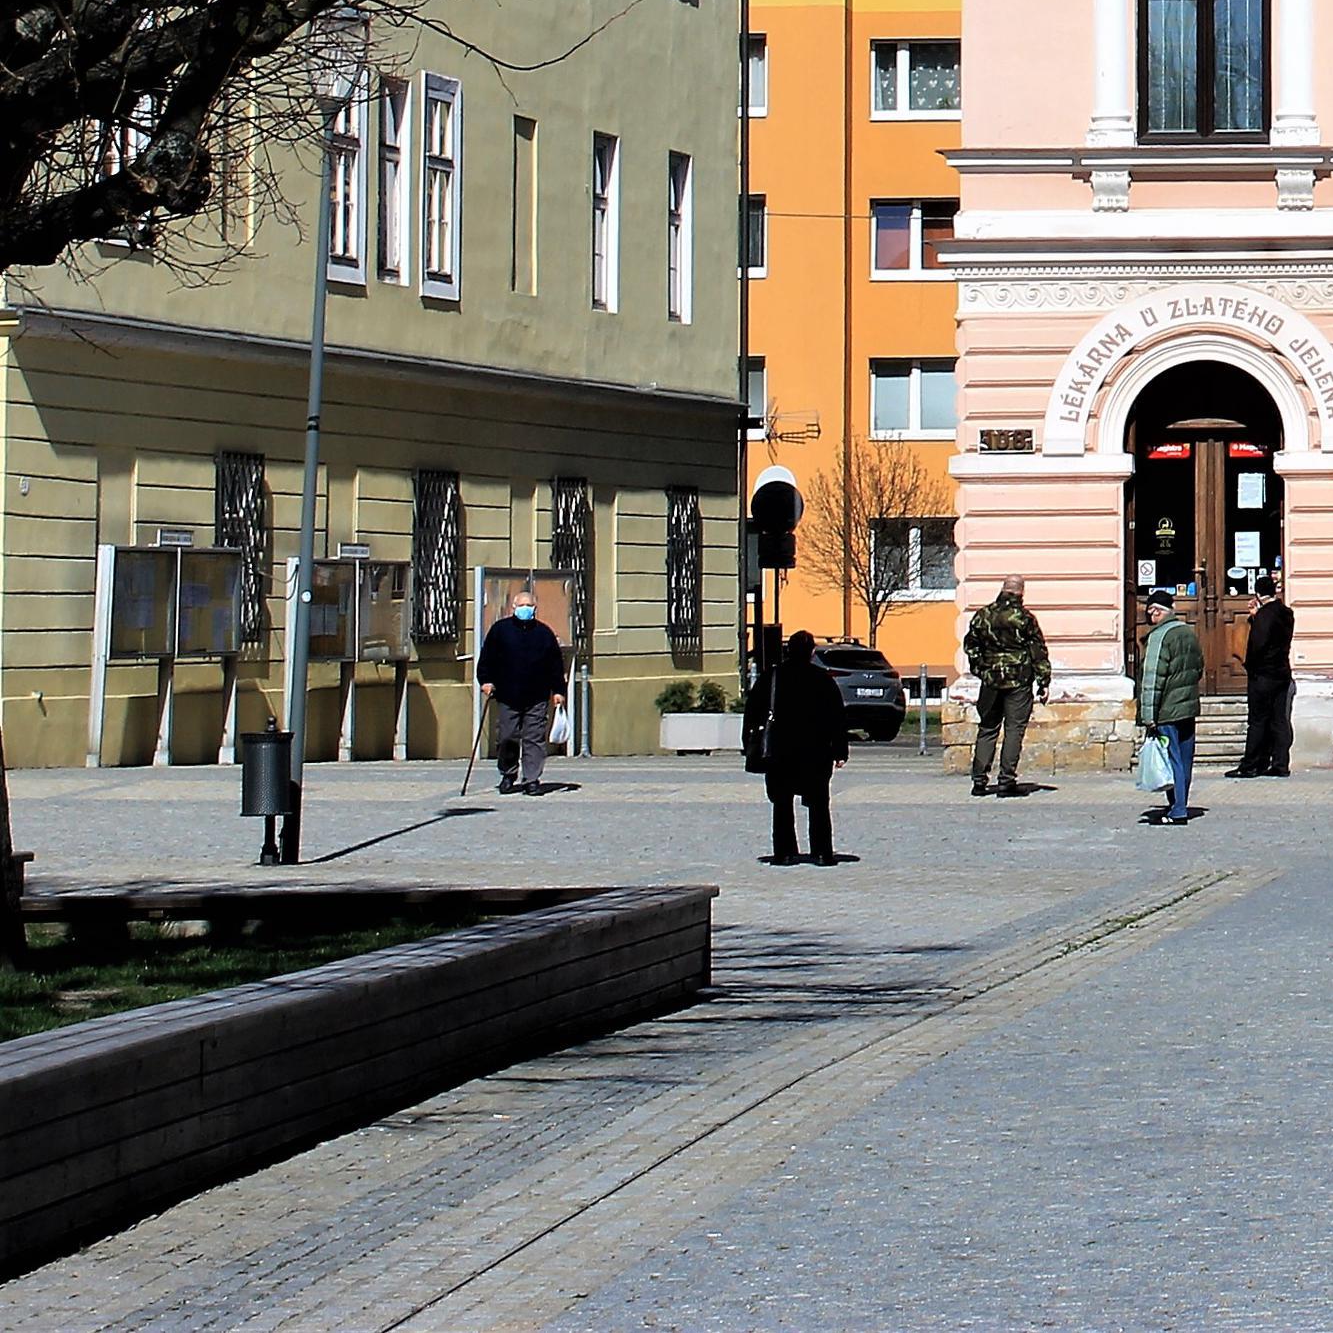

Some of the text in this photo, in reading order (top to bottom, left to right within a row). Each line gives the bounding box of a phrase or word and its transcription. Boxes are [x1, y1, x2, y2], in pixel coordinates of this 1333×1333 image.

[1059, 322, 1134, 424] LÉKÁRNA
[1139, 306, 1159, 327] U
[1166, 296, 1286, 335] ZLATÉHO
